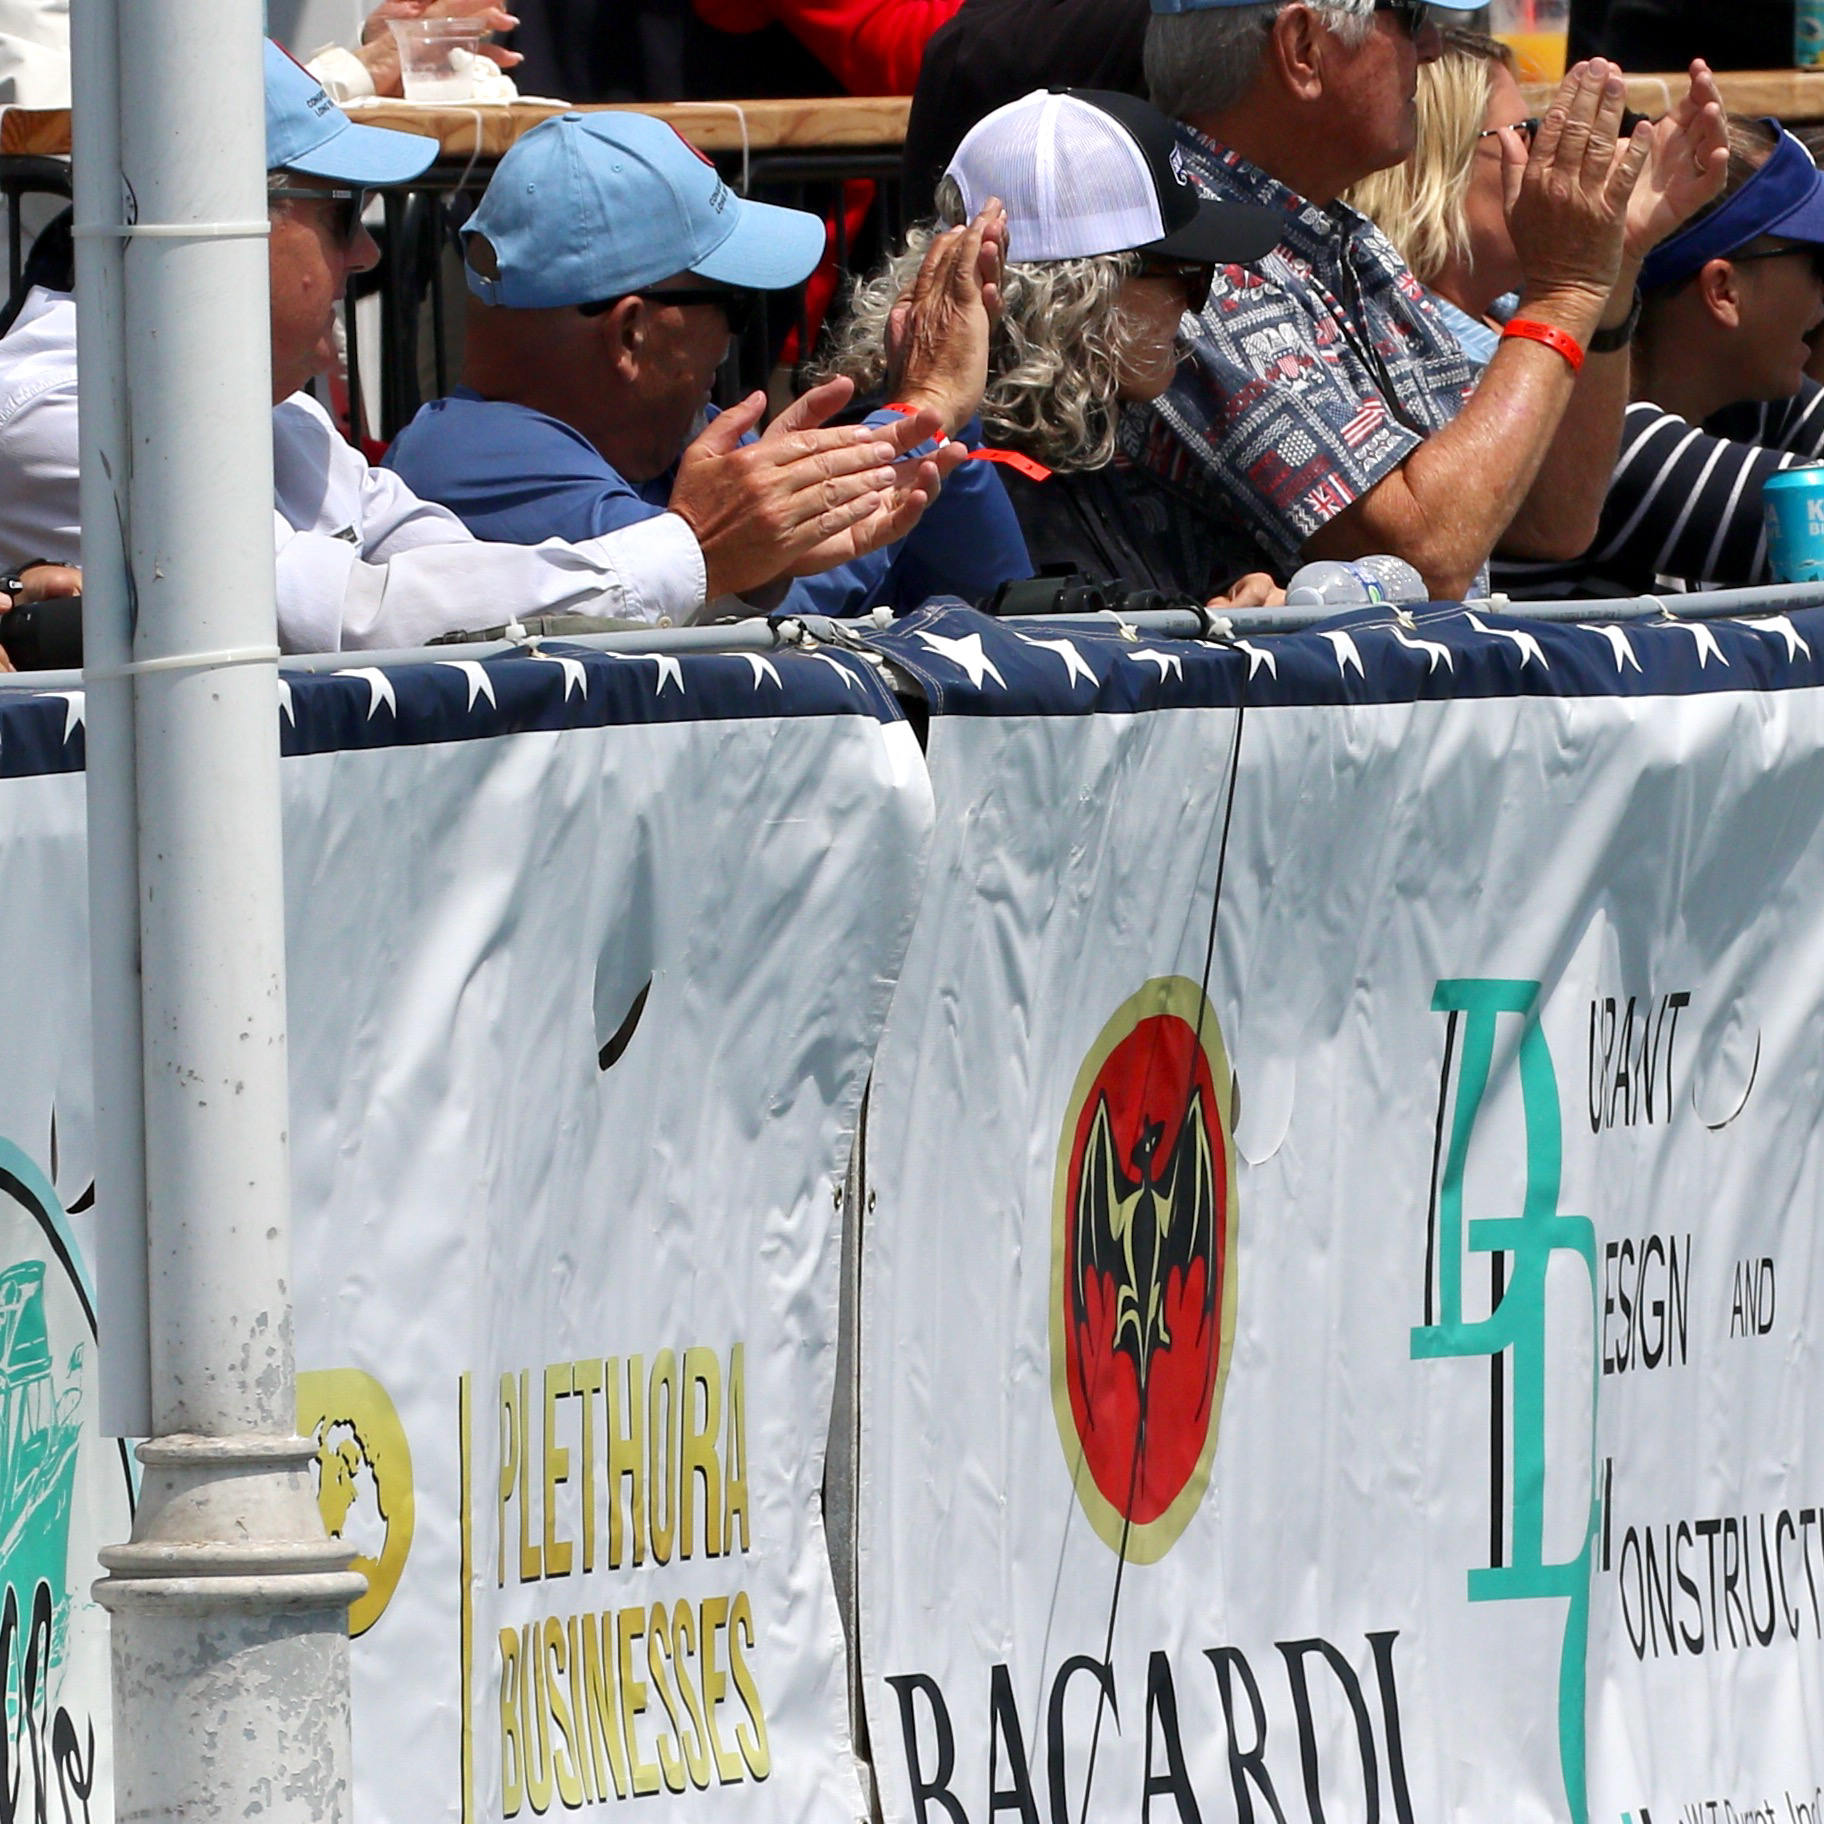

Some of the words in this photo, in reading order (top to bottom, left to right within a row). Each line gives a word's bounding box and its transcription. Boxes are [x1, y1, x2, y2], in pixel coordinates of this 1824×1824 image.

[1730, 1256, 1776, 1339] AND
[497, 1341, 751, 1588] PLETHORA
[497, 1589, 772, 1820] BUSINESSES
[885, 1629, 1415, 1824] BACARDI
